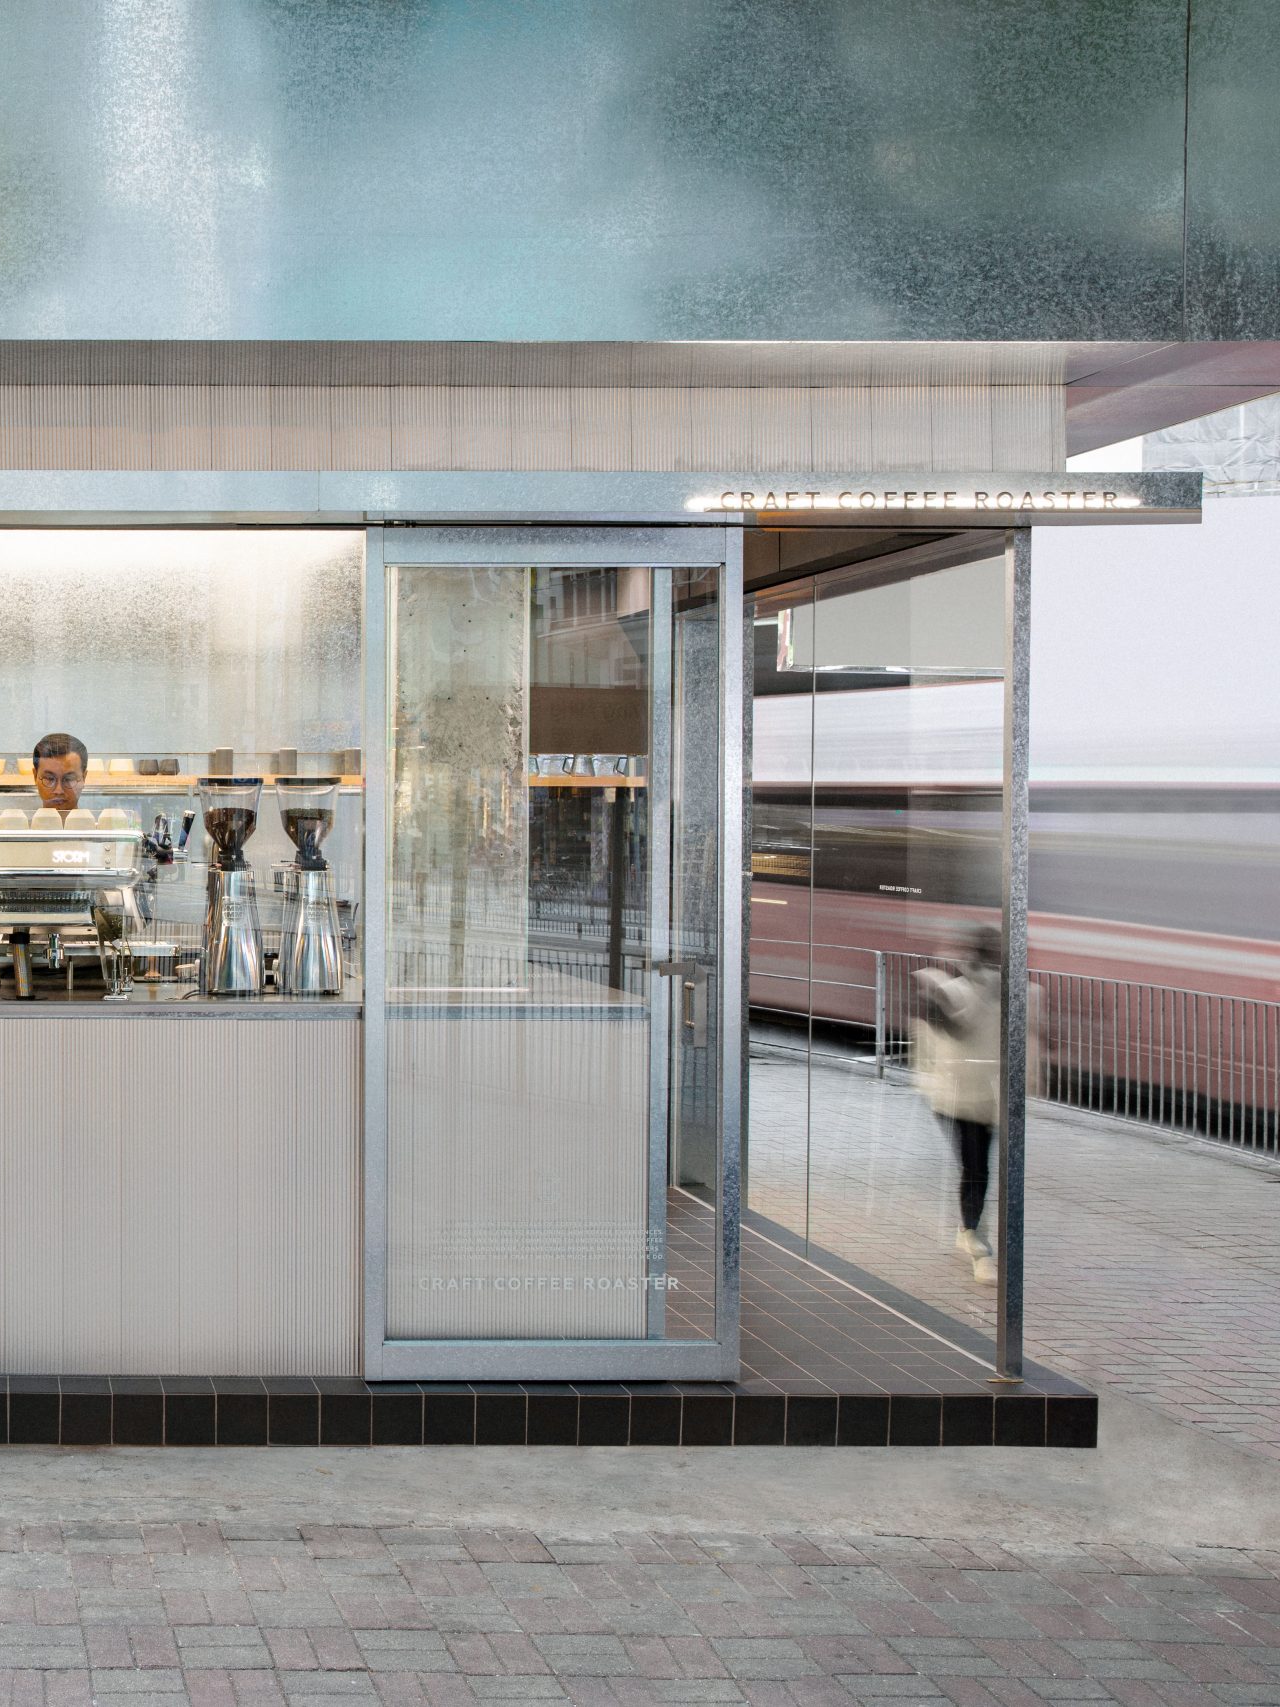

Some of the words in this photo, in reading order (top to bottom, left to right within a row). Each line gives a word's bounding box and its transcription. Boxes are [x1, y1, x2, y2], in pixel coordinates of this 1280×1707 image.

[720, 491, 820, 509] CRAFT
[838, 491, 956, 509] COFFEE
[975, 491, 1118, 509] ROASTER
[52, 850, 90, 863] STORM
[420, 1277, 486, 1290] CRAFT
[495, 1277, 574, 1290] COFFEE
[583, 1277, 679, 1290] ROASTER
